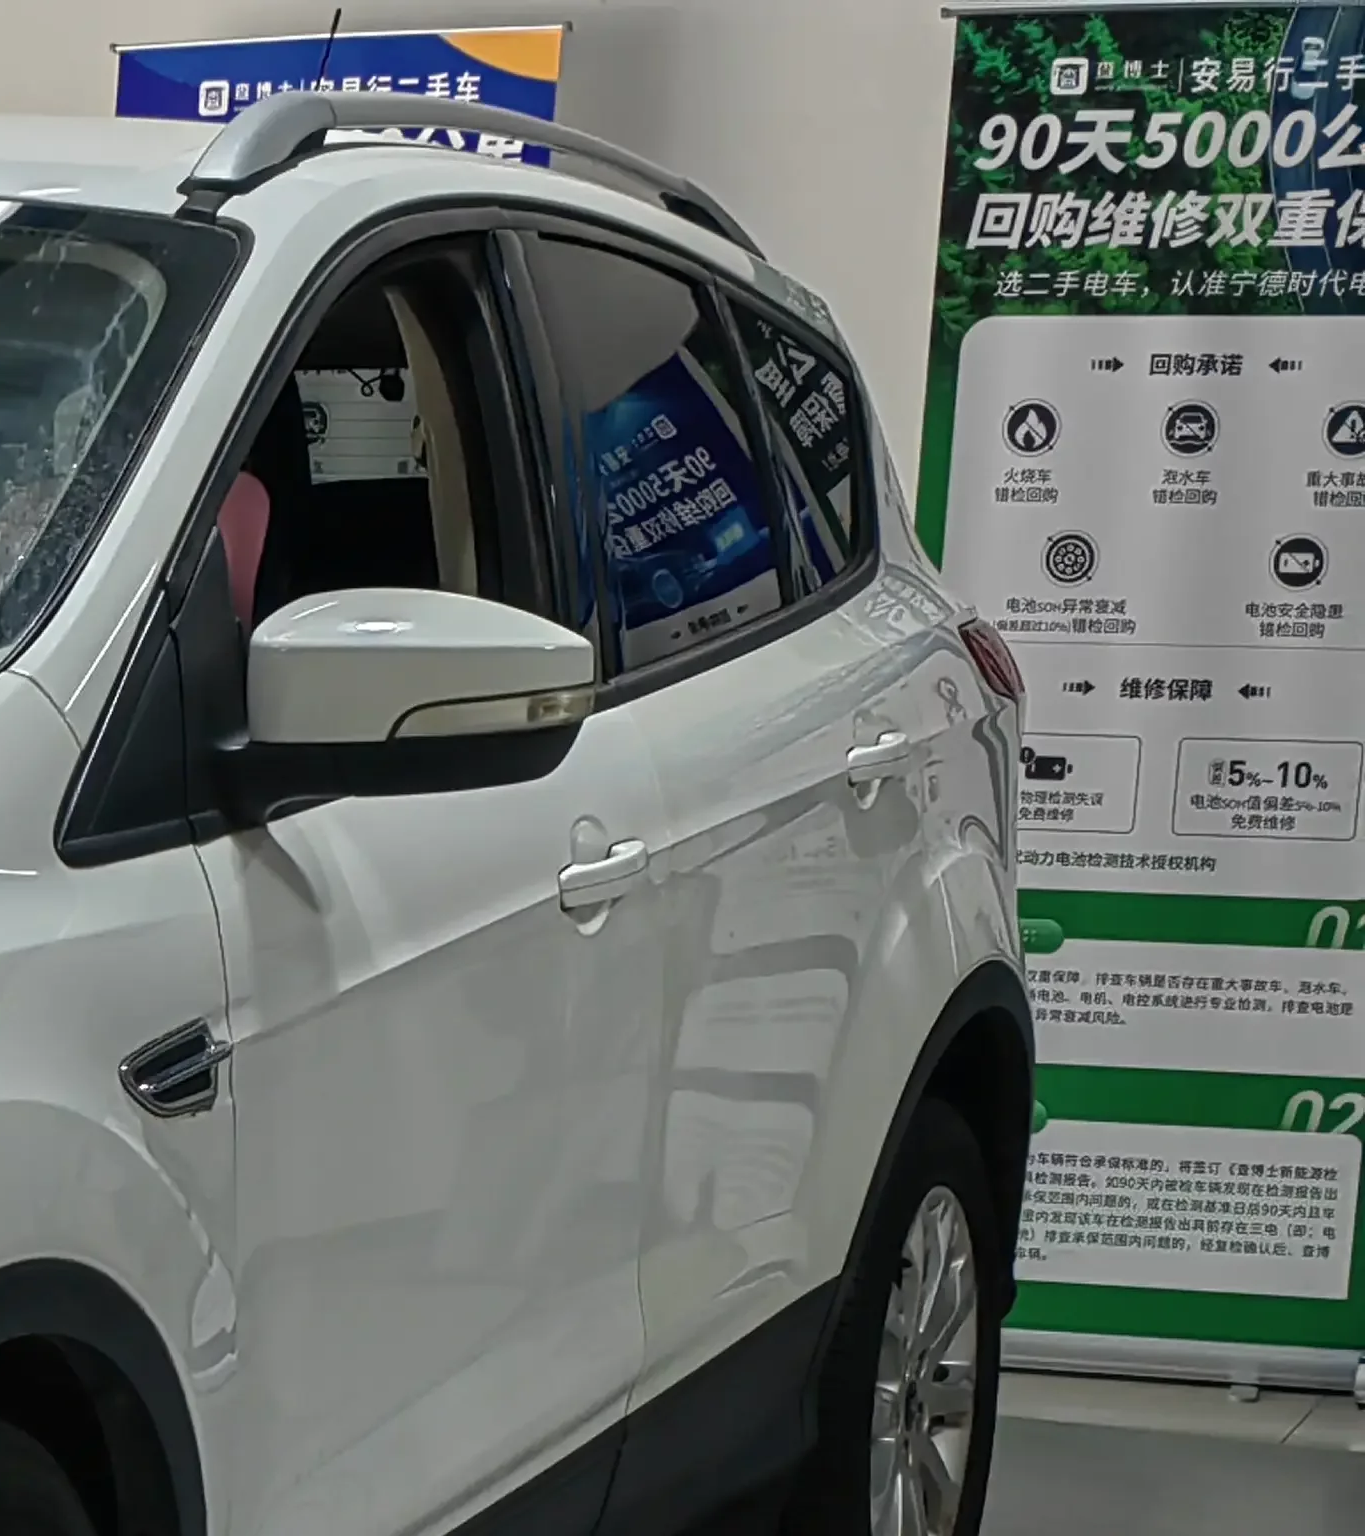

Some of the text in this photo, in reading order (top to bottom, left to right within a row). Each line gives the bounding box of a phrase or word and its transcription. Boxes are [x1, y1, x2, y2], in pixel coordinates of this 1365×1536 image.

[1149, 353, 1244, 377] 回购承诺
[1003, 467, 1053, 485] 火烧车
[1161, 468, 1212, 486] 泡水车
[1312, 490, 1365, 508] 错检回
[1259, 621, 1325, 639] 错检回购
[1119, 677, 1214, 702] 维修保障
[1231, 813, 1297, 831] 免费维修
